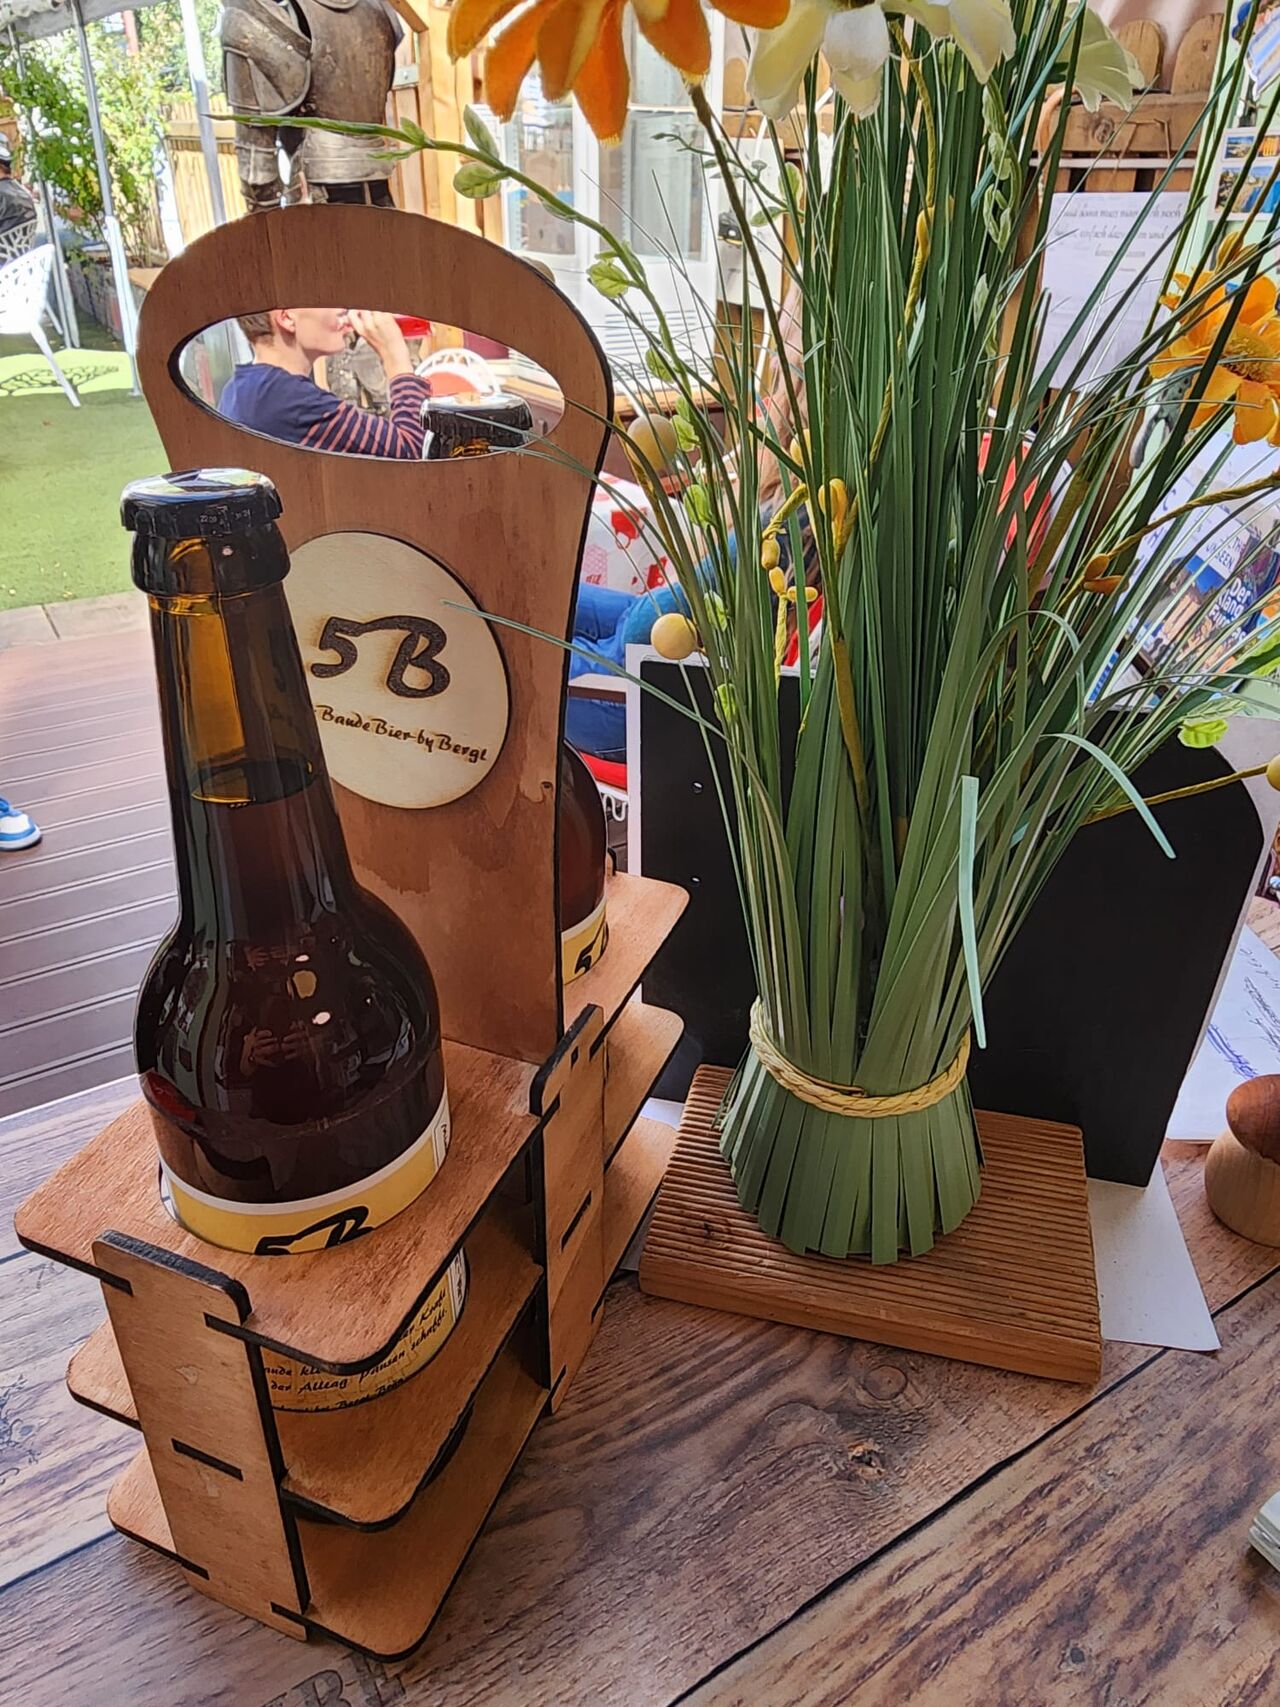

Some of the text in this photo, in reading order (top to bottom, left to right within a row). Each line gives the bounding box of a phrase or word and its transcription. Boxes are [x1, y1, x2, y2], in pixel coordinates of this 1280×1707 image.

[1230, 578, 1251, 604] Der
[315, 704, 370, 731] Baude
[271, 1379, 291, 1391] der
[297, 1378, 348, 1395] Alltag
